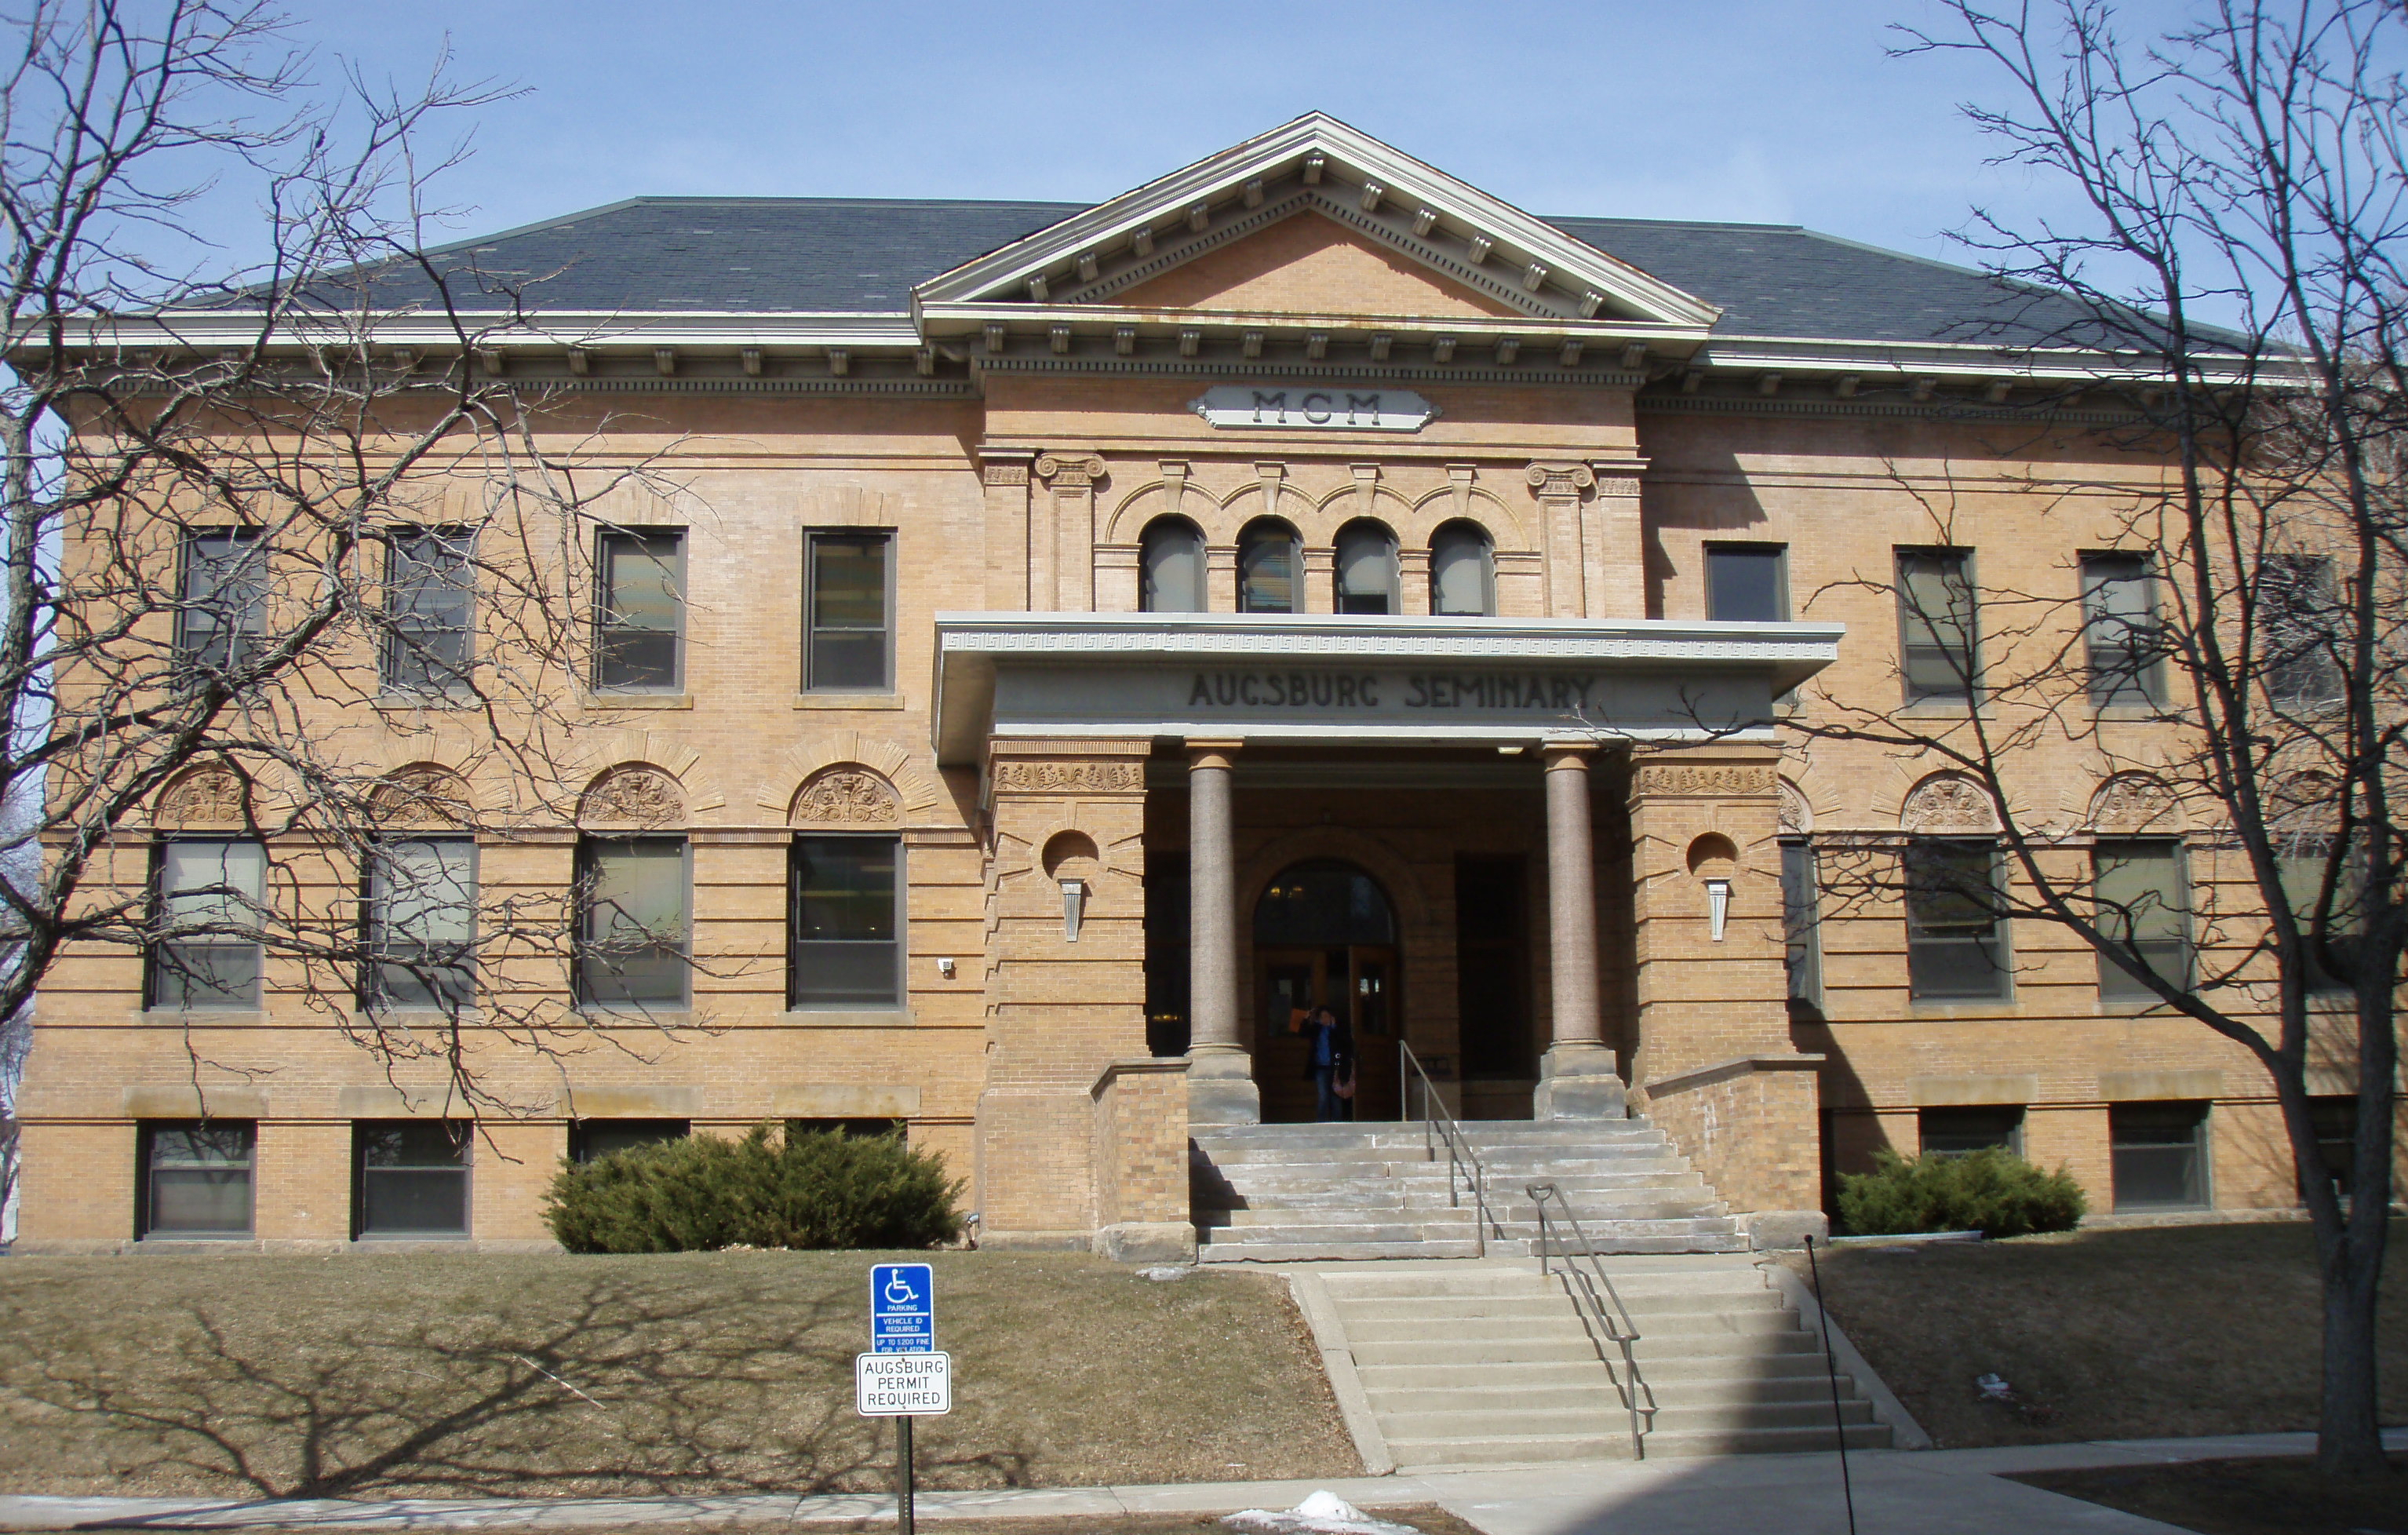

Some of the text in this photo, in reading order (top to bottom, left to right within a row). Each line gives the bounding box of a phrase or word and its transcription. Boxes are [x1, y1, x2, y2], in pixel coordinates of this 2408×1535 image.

[1251, 390, 1380, 426] MCM
[1189, 673, 1595, 709] AUGSBURG SEMINARY
[865, 1361, 944, 1375] AUGSBURG
[878, 1376, 930, 1390] PERMIT
[868, 1391, 941, 1406] REQUIRED
